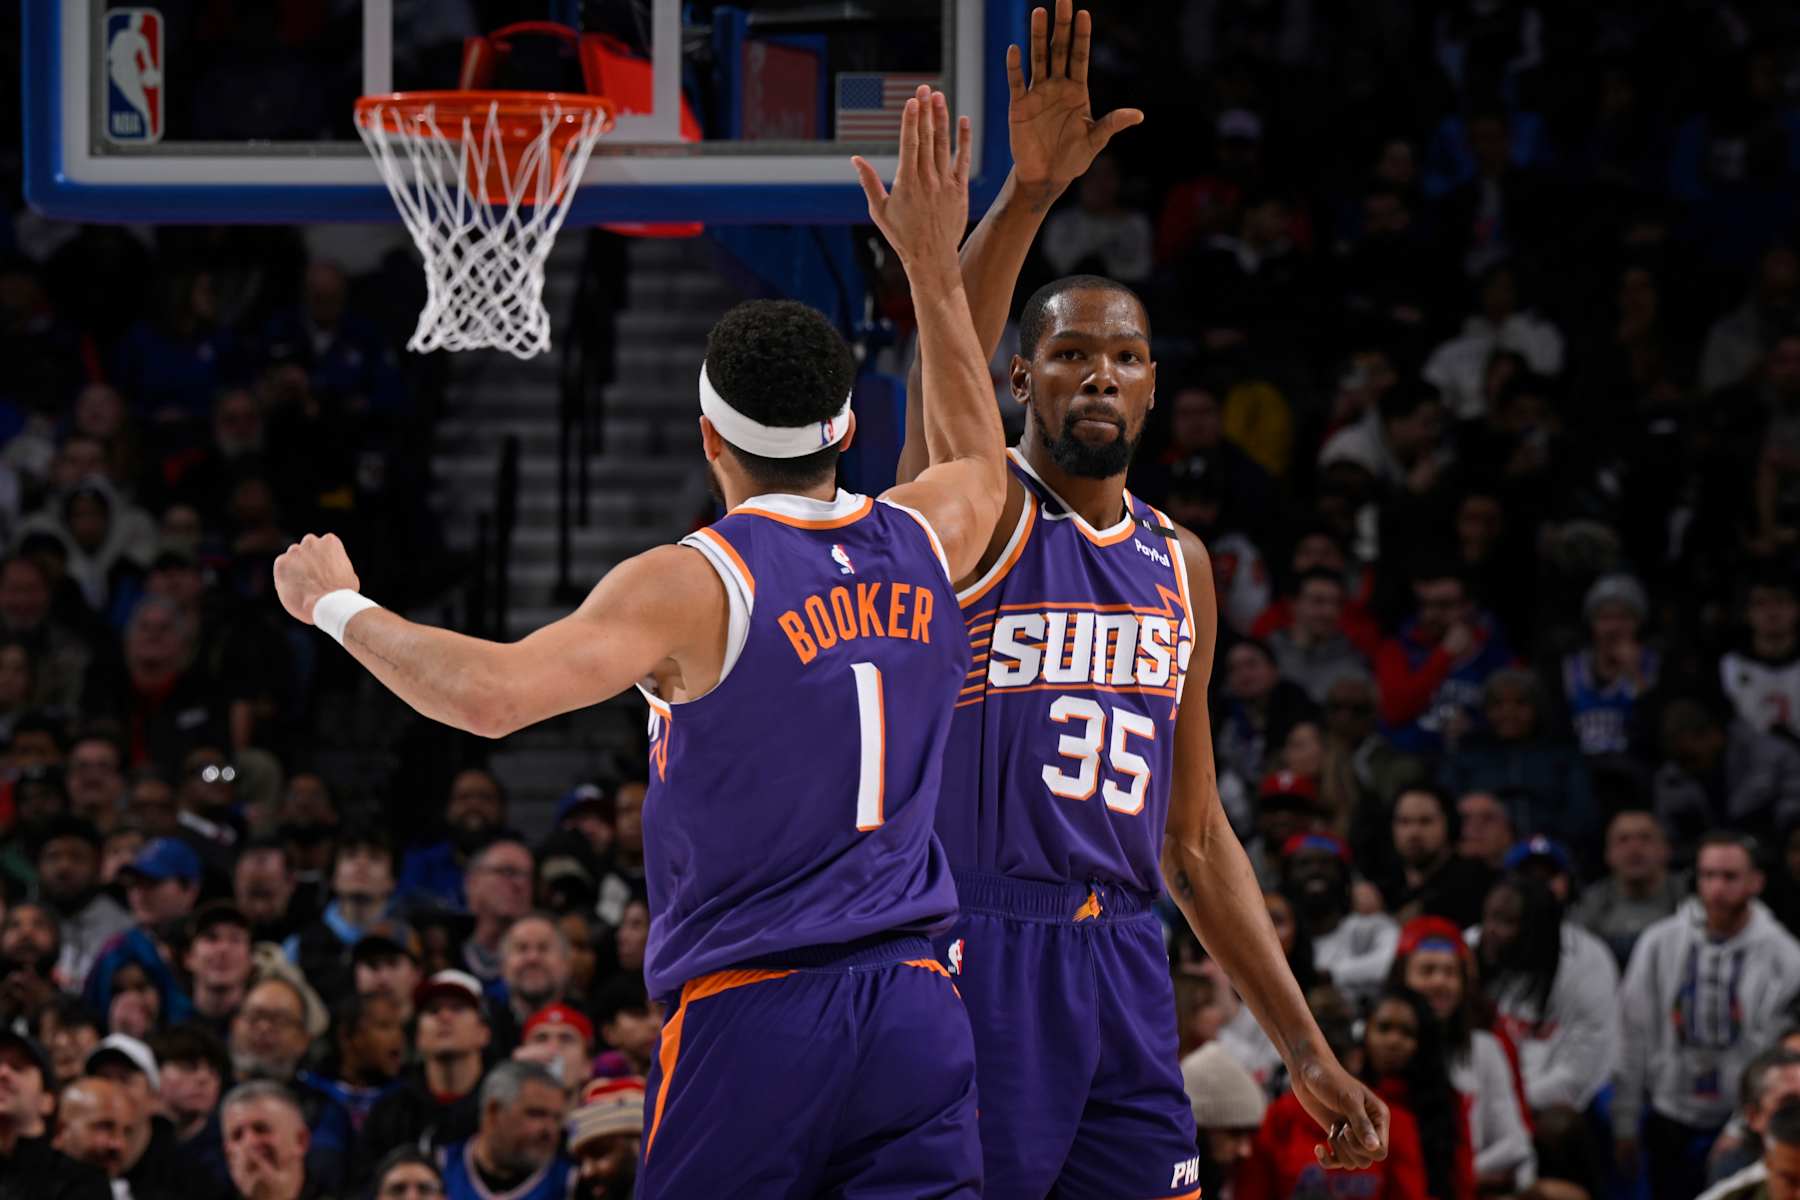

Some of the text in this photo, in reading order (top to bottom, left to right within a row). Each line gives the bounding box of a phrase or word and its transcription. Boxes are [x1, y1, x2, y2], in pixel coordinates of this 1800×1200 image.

[1134, 538, 1171, 568] PayPal
[776, 582, 934, 665] BOOKER
[987, 611, 1172, 688] SUNS
[850, 661, 886, 832] 1
[1041, 694, 1155, 816] 35
